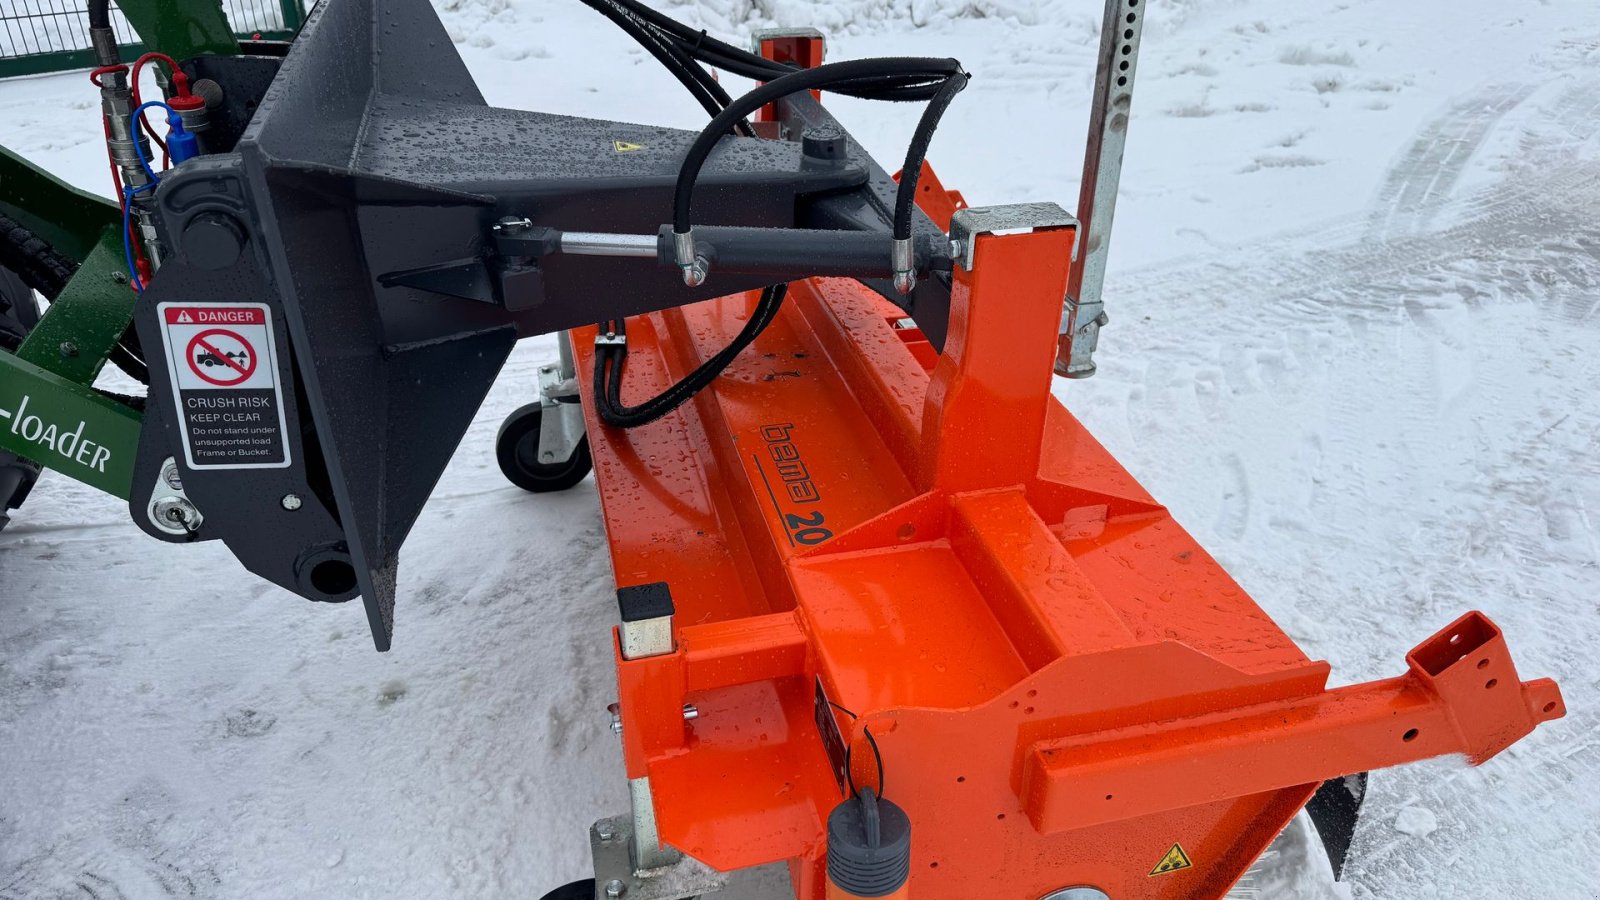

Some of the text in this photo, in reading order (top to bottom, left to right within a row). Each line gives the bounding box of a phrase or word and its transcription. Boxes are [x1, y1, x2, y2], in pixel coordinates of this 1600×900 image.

[198, 311, 255, 322] DANGER
[187, 397, 270, 409] CRUSH RISK
[190, 413, 261, 422] KEEP CLEAR
[193, 427, 206, 435] Do
[208, 427, 222, 435] not
[250, 426, 276, 434] under
[195, 437, 271, 447] unsupported load
[238, 448, 272, 456] Bucket.
[760, 423, 833, 545] bema 20
